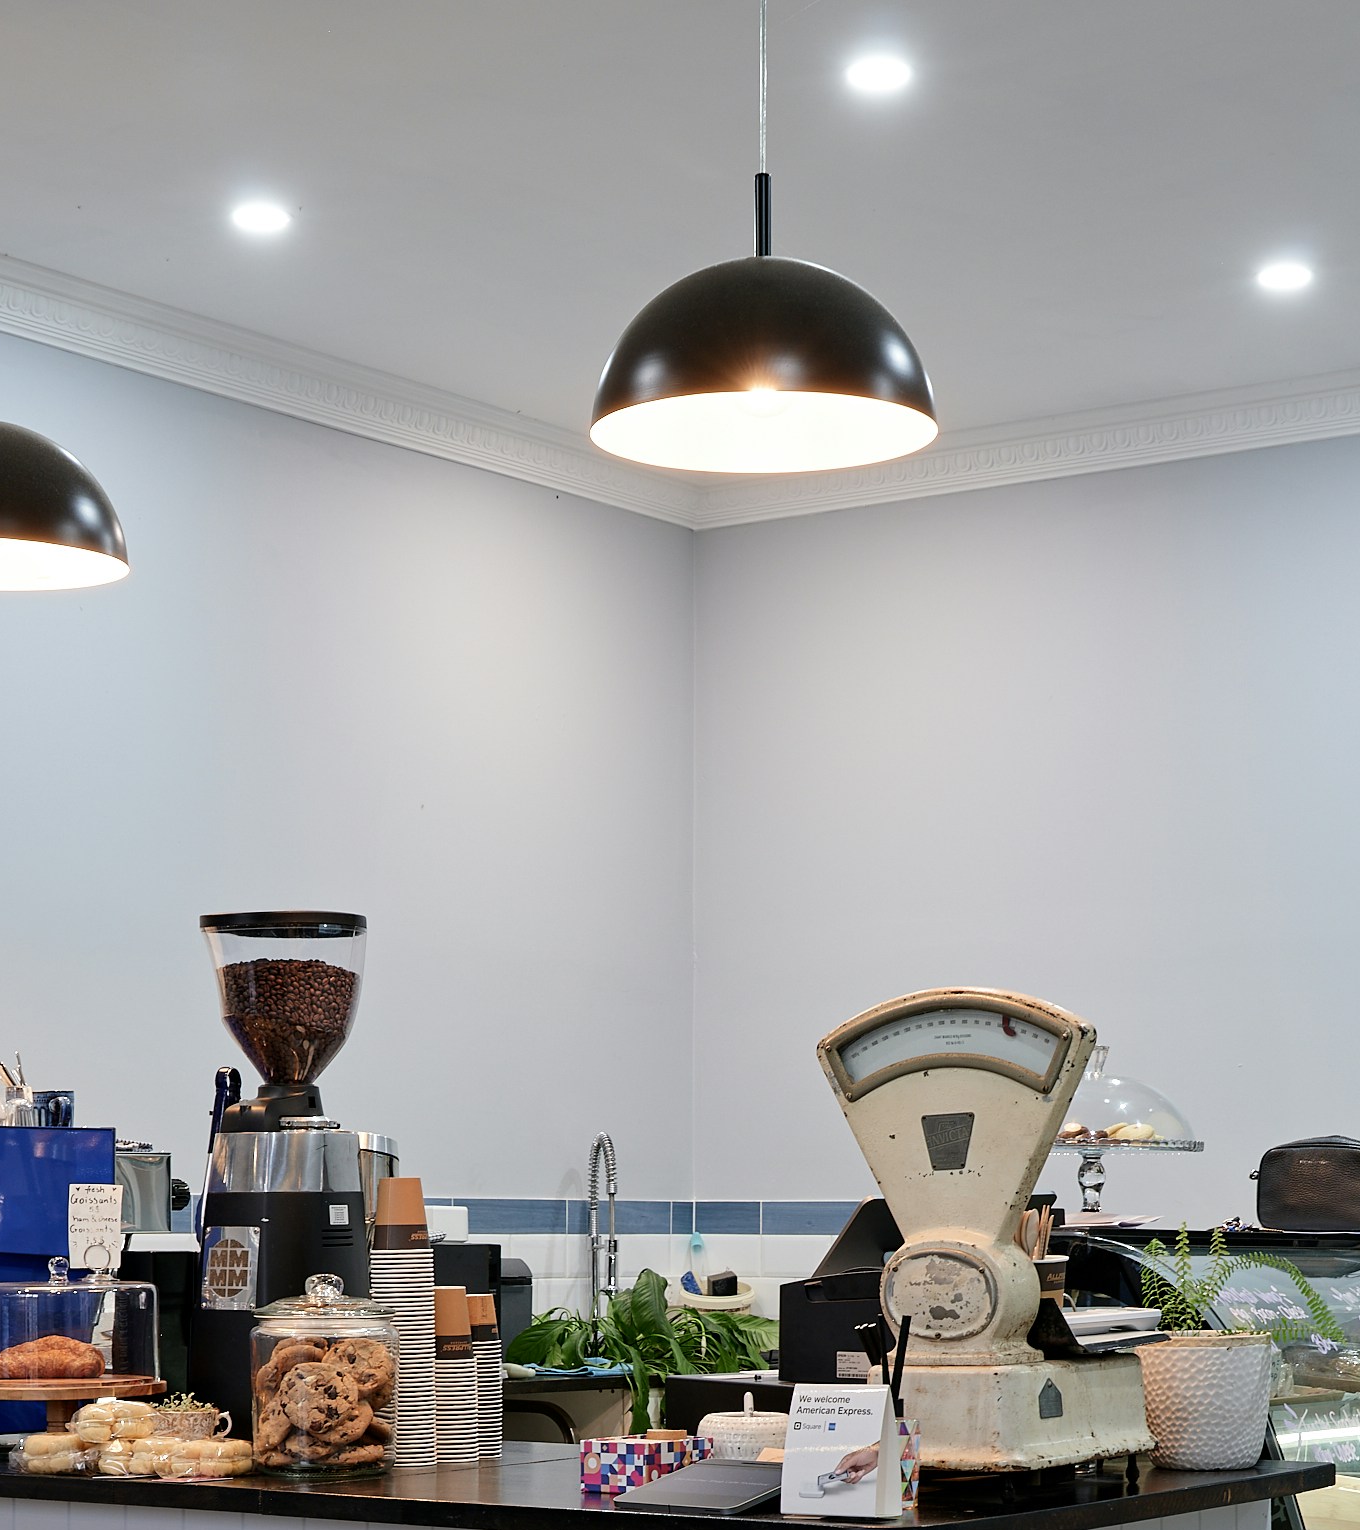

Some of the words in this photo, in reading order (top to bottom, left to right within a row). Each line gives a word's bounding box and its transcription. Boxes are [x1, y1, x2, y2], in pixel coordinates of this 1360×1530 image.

[799, 1395, 812, 1403] We
[814, 1395, 851, 1404] welcome
[796, 1406, 836, 1415] American
[837, 1406, 874, 1417] Express.
